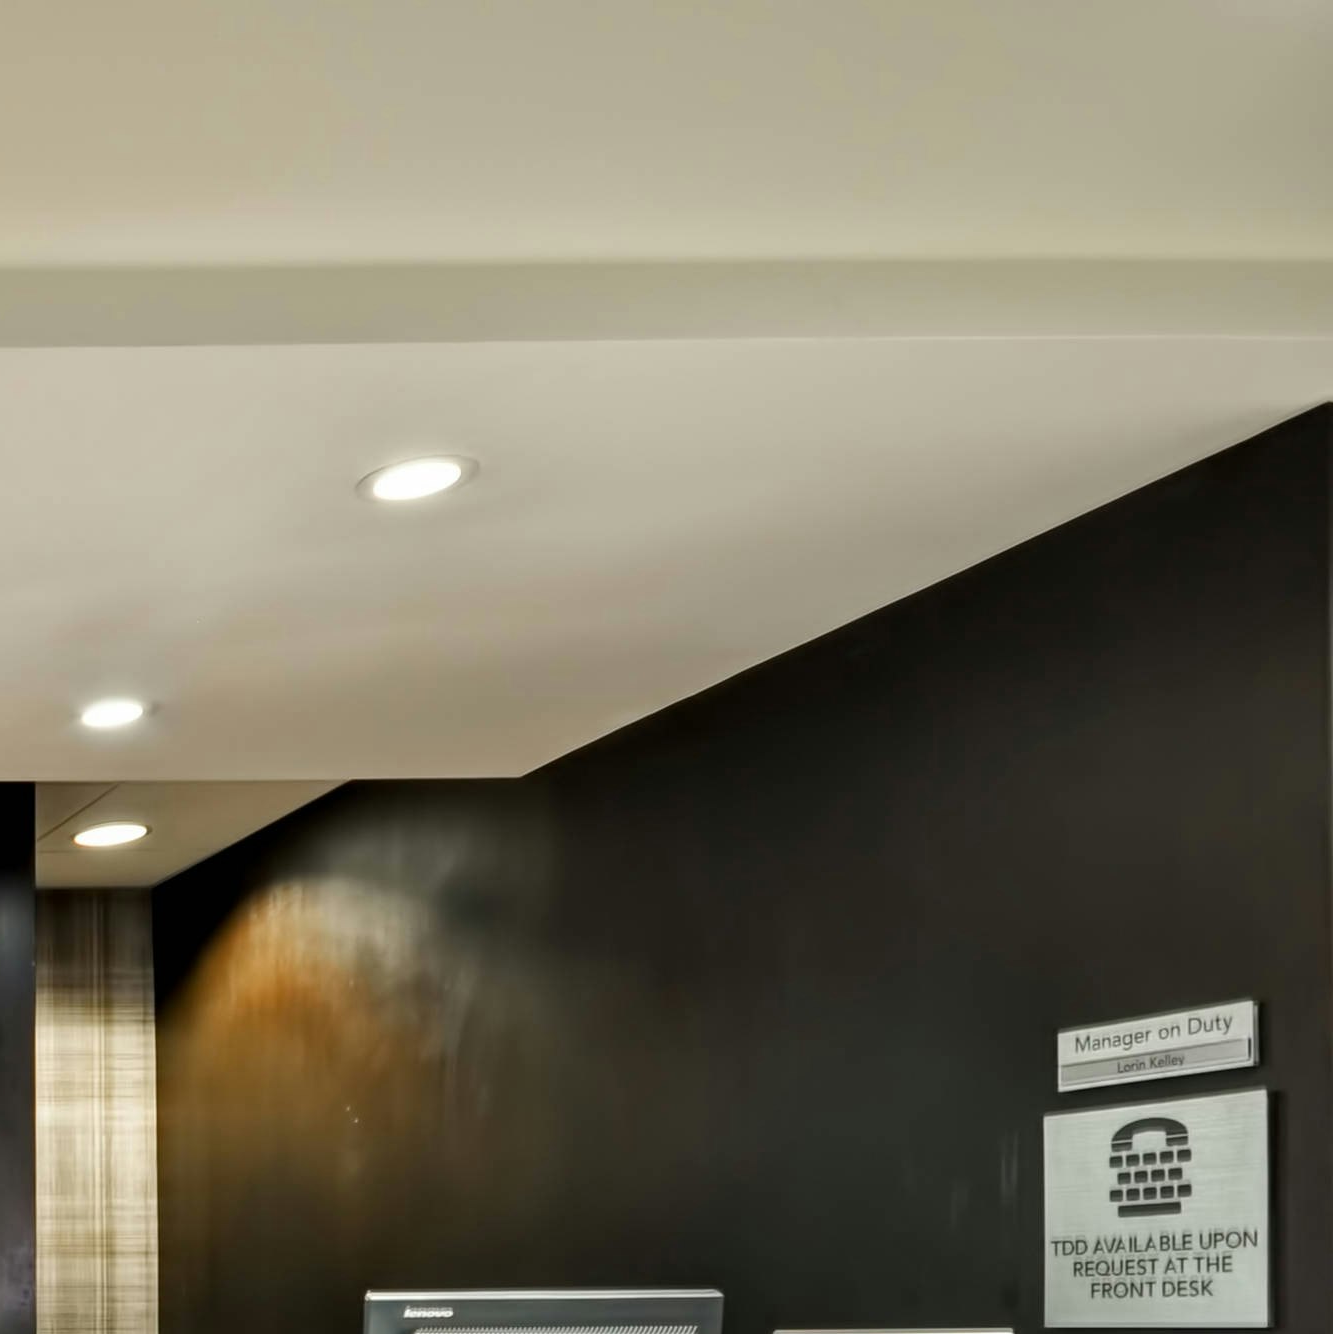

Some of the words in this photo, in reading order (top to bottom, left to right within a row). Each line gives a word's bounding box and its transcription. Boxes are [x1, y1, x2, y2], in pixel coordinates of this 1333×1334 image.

[1075, 1029, 1152, 1054] Manager
[1158, 1025, 1181, 1041] on
[1188, 1015, 1233, 1035] Duty
[1150, 1055, 1185, 1069] Kelley
[1051, 1239, 1088, 1256] TDD
[1093, 1234, 1193, 1255] AVAILABLE
[1199, 1229, 1258, 1250] UPON
[1073, 1258, 1159, 1277] REQUEST
[1164, 1257, 1189, 1274] AT
[1193, 1255, 1233, 1273] THE
[1091, 1281, 1157, 1299] FRONT
[1162, 1279, 1214, 1297] DESK
[403, 1305, 454, 1318] lenovo
